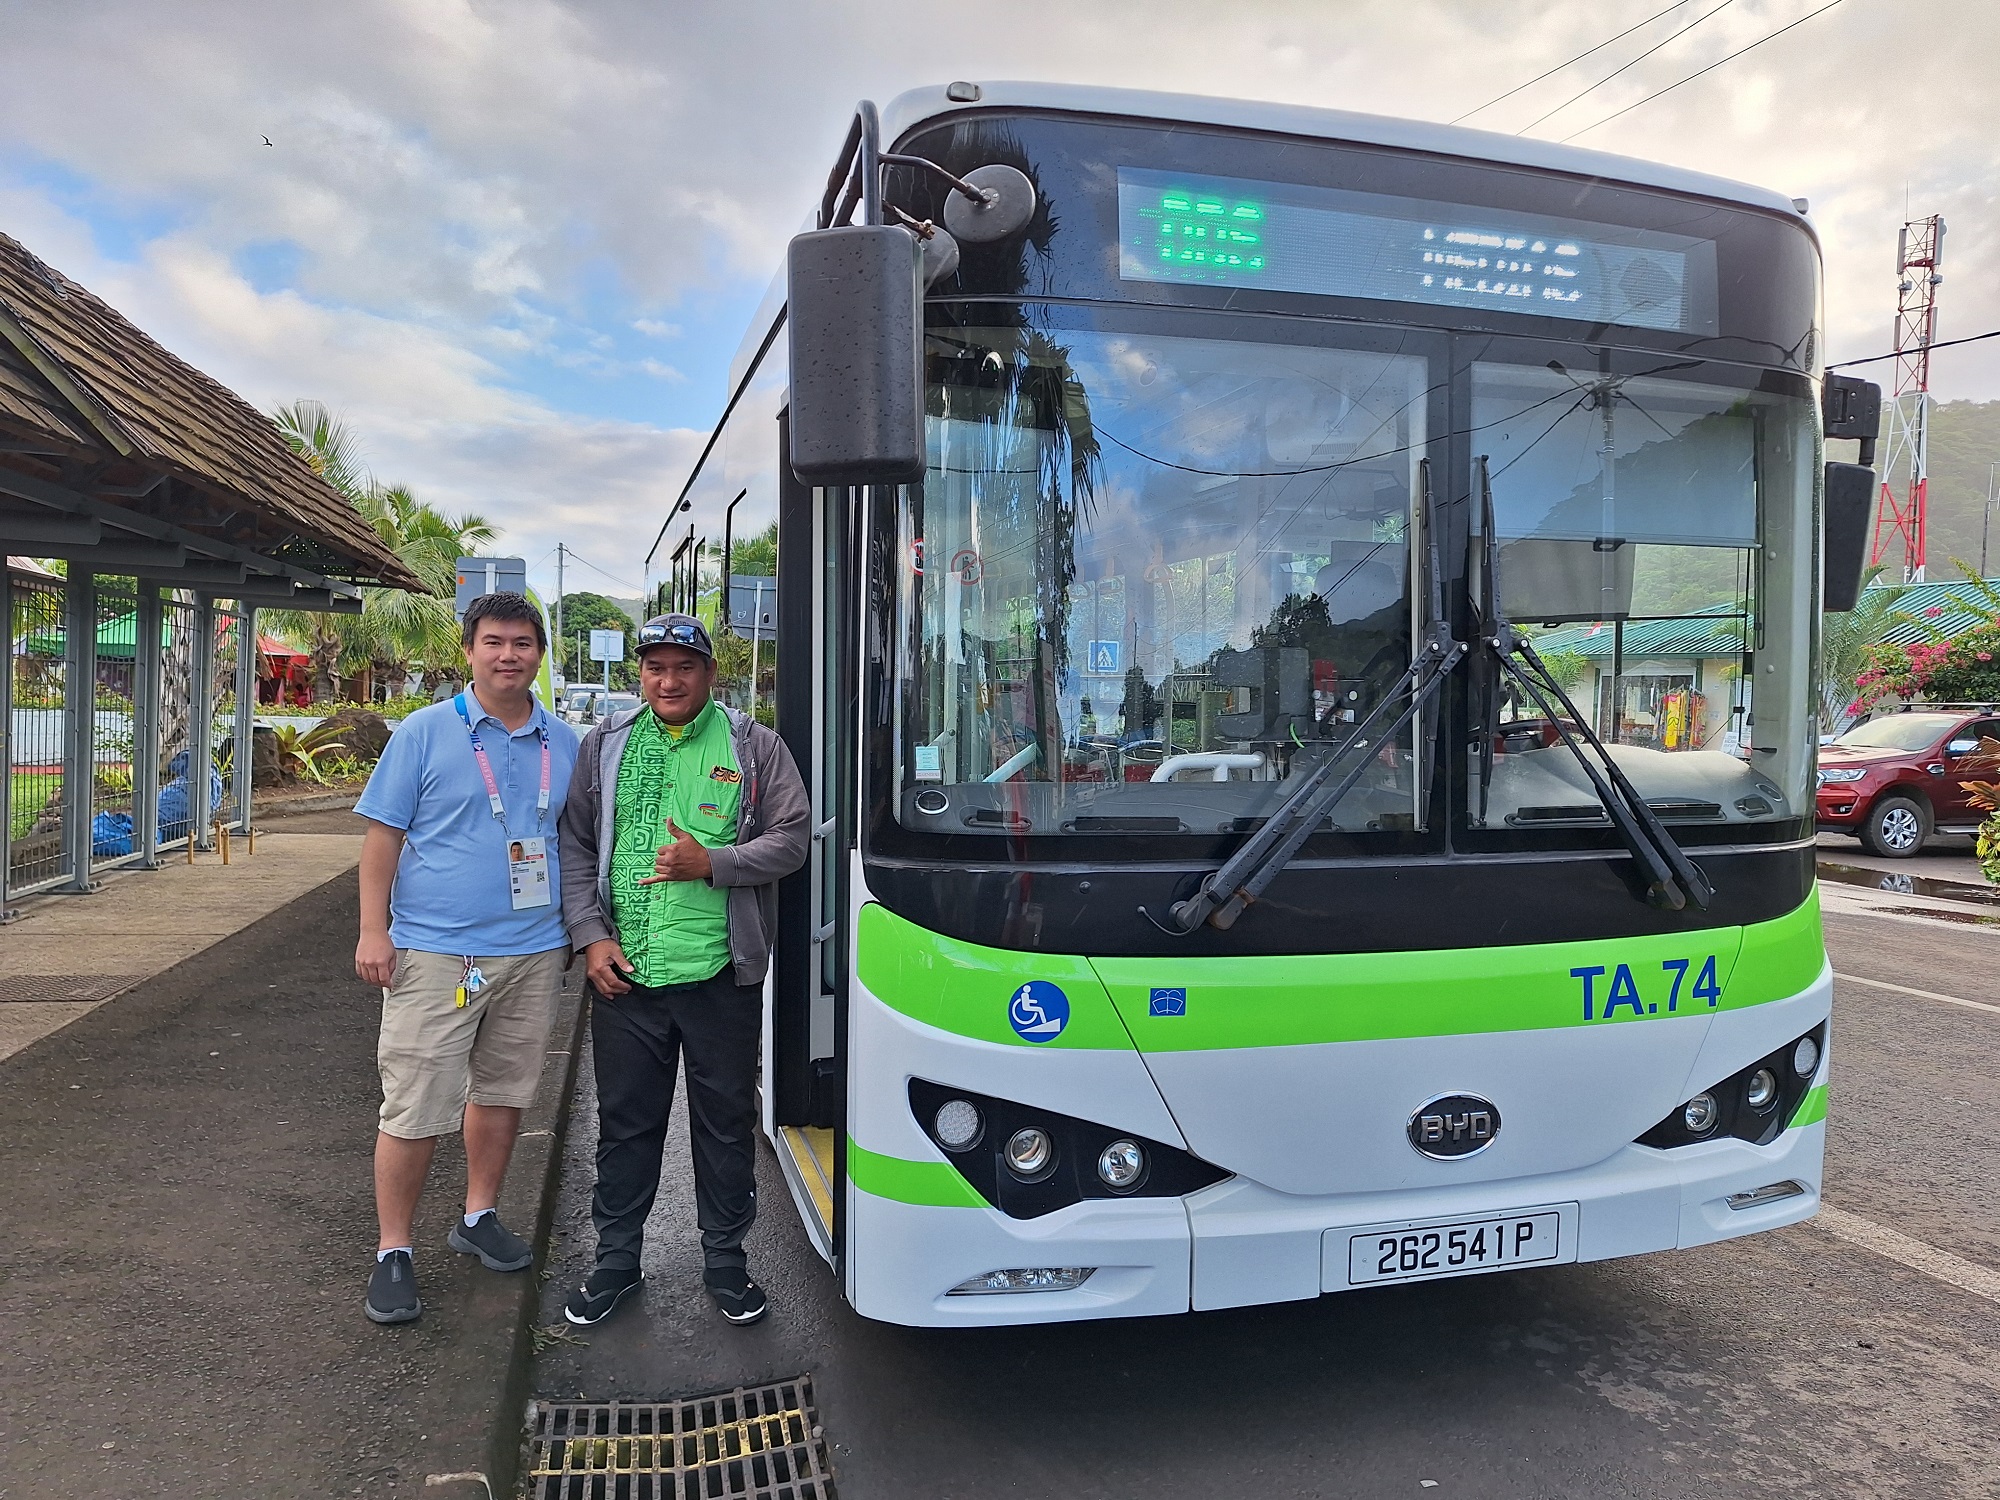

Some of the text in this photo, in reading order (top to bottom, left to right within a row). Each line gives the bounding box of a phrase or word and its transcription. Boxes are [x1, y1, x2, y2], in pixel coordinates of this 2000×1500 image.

[1569, 955, 1721, 1021] TA.74
[1420, 1111, 1491, 1143] BYD
[1377, 1221, 1534, 1275] 262 541 P
